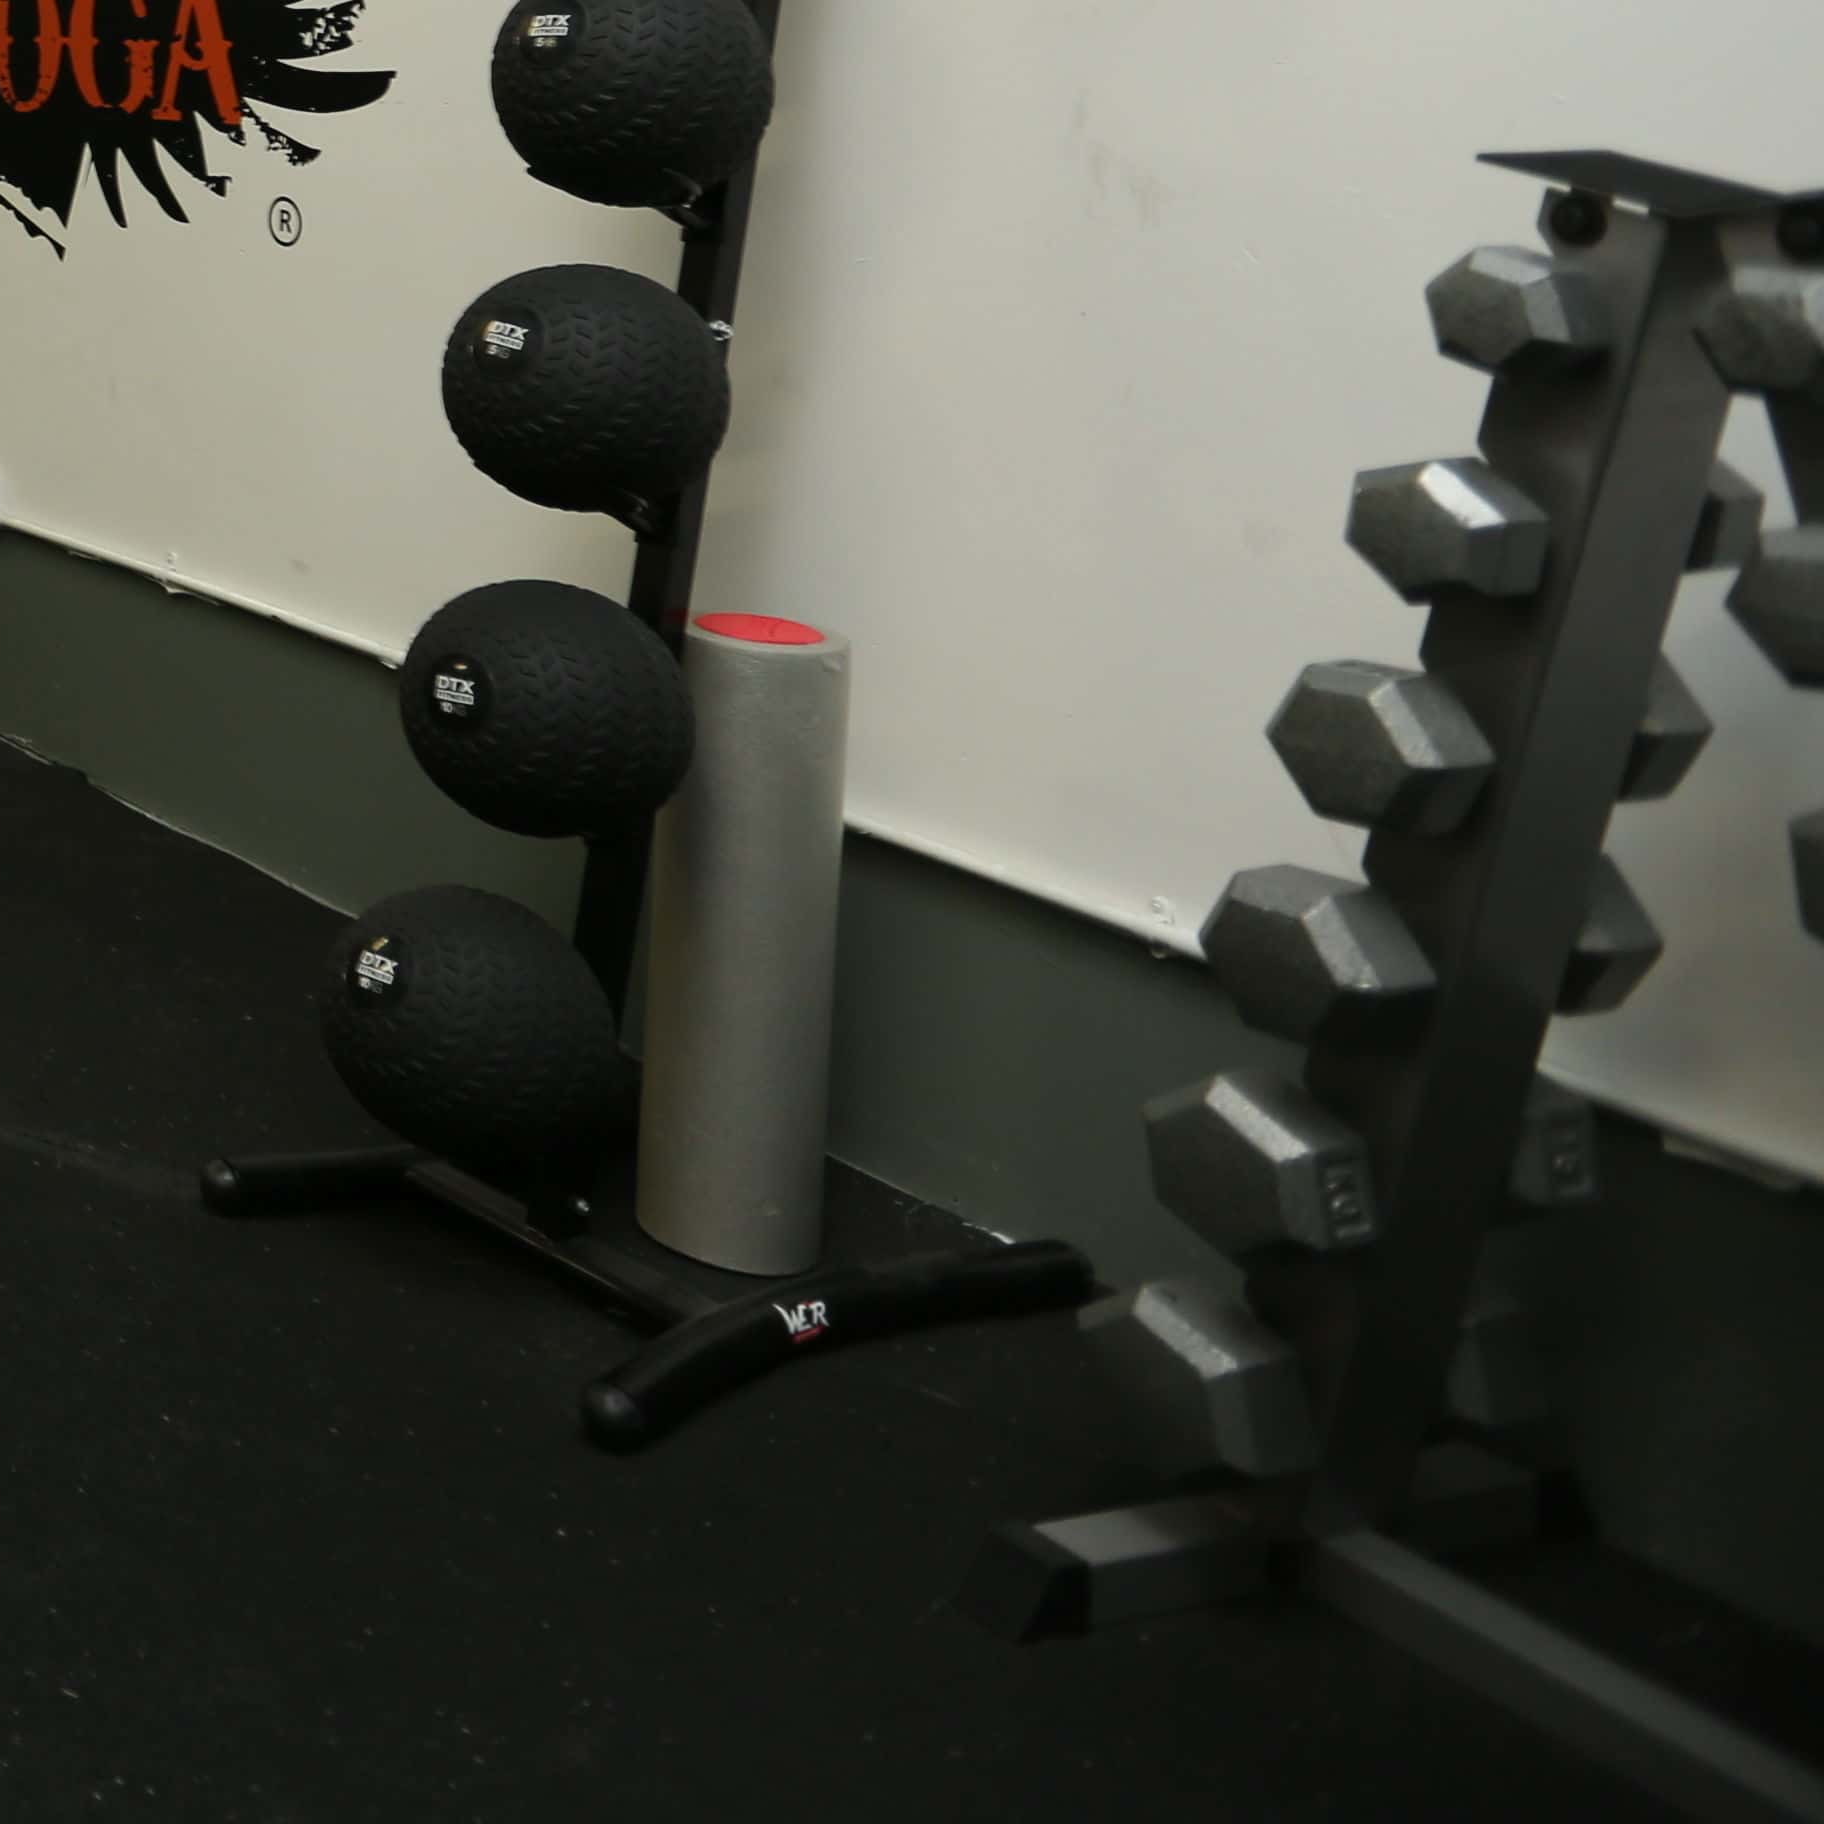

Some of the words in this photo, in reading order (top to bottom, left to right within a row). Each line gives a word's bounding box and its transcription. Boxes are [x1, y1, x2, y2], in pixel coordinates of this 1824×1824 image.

[531, 14, 571, 27] DTX
[487, 320, 529, 341] DTX
[435, 675, 475, 694] DTX
[360, 950, 399, 975] DTX
